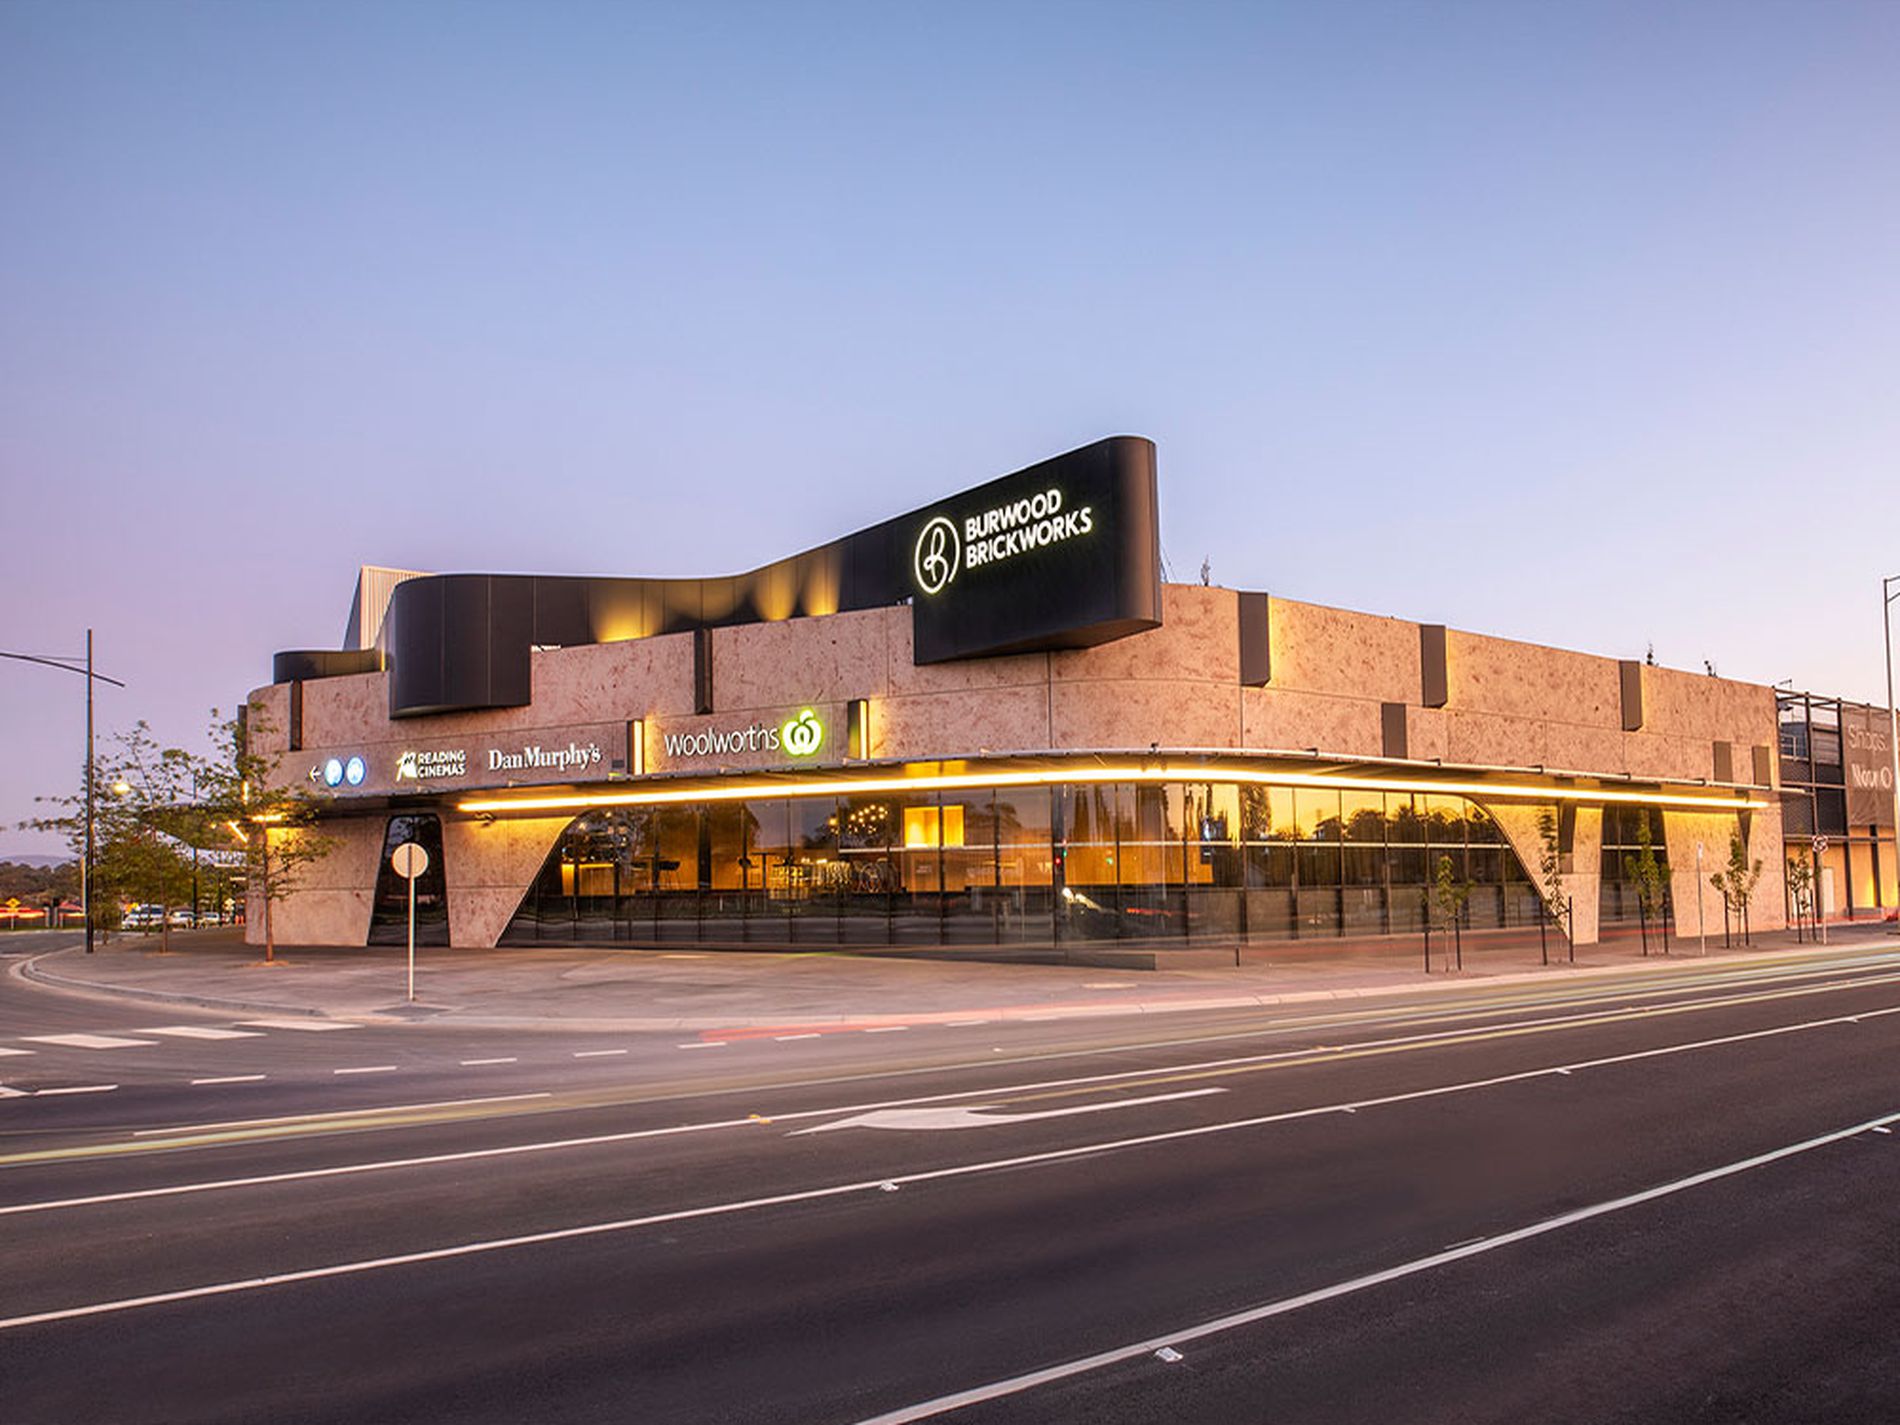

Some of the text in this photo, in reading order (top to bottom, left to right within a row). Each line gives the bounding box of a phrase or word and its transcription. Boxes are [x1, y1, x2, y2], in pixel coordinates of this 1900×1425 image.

[965, 488, 1063, 542] BURWOOD
[965, 507, 1093, 569] BRICKWORKS
[664, 725, 780, 757] woolworths
[417, 750, 466, 765] READING
[417, 764, 466, 778] CINEMAS
[488, 743, 601, 771] Dan Murphy's
